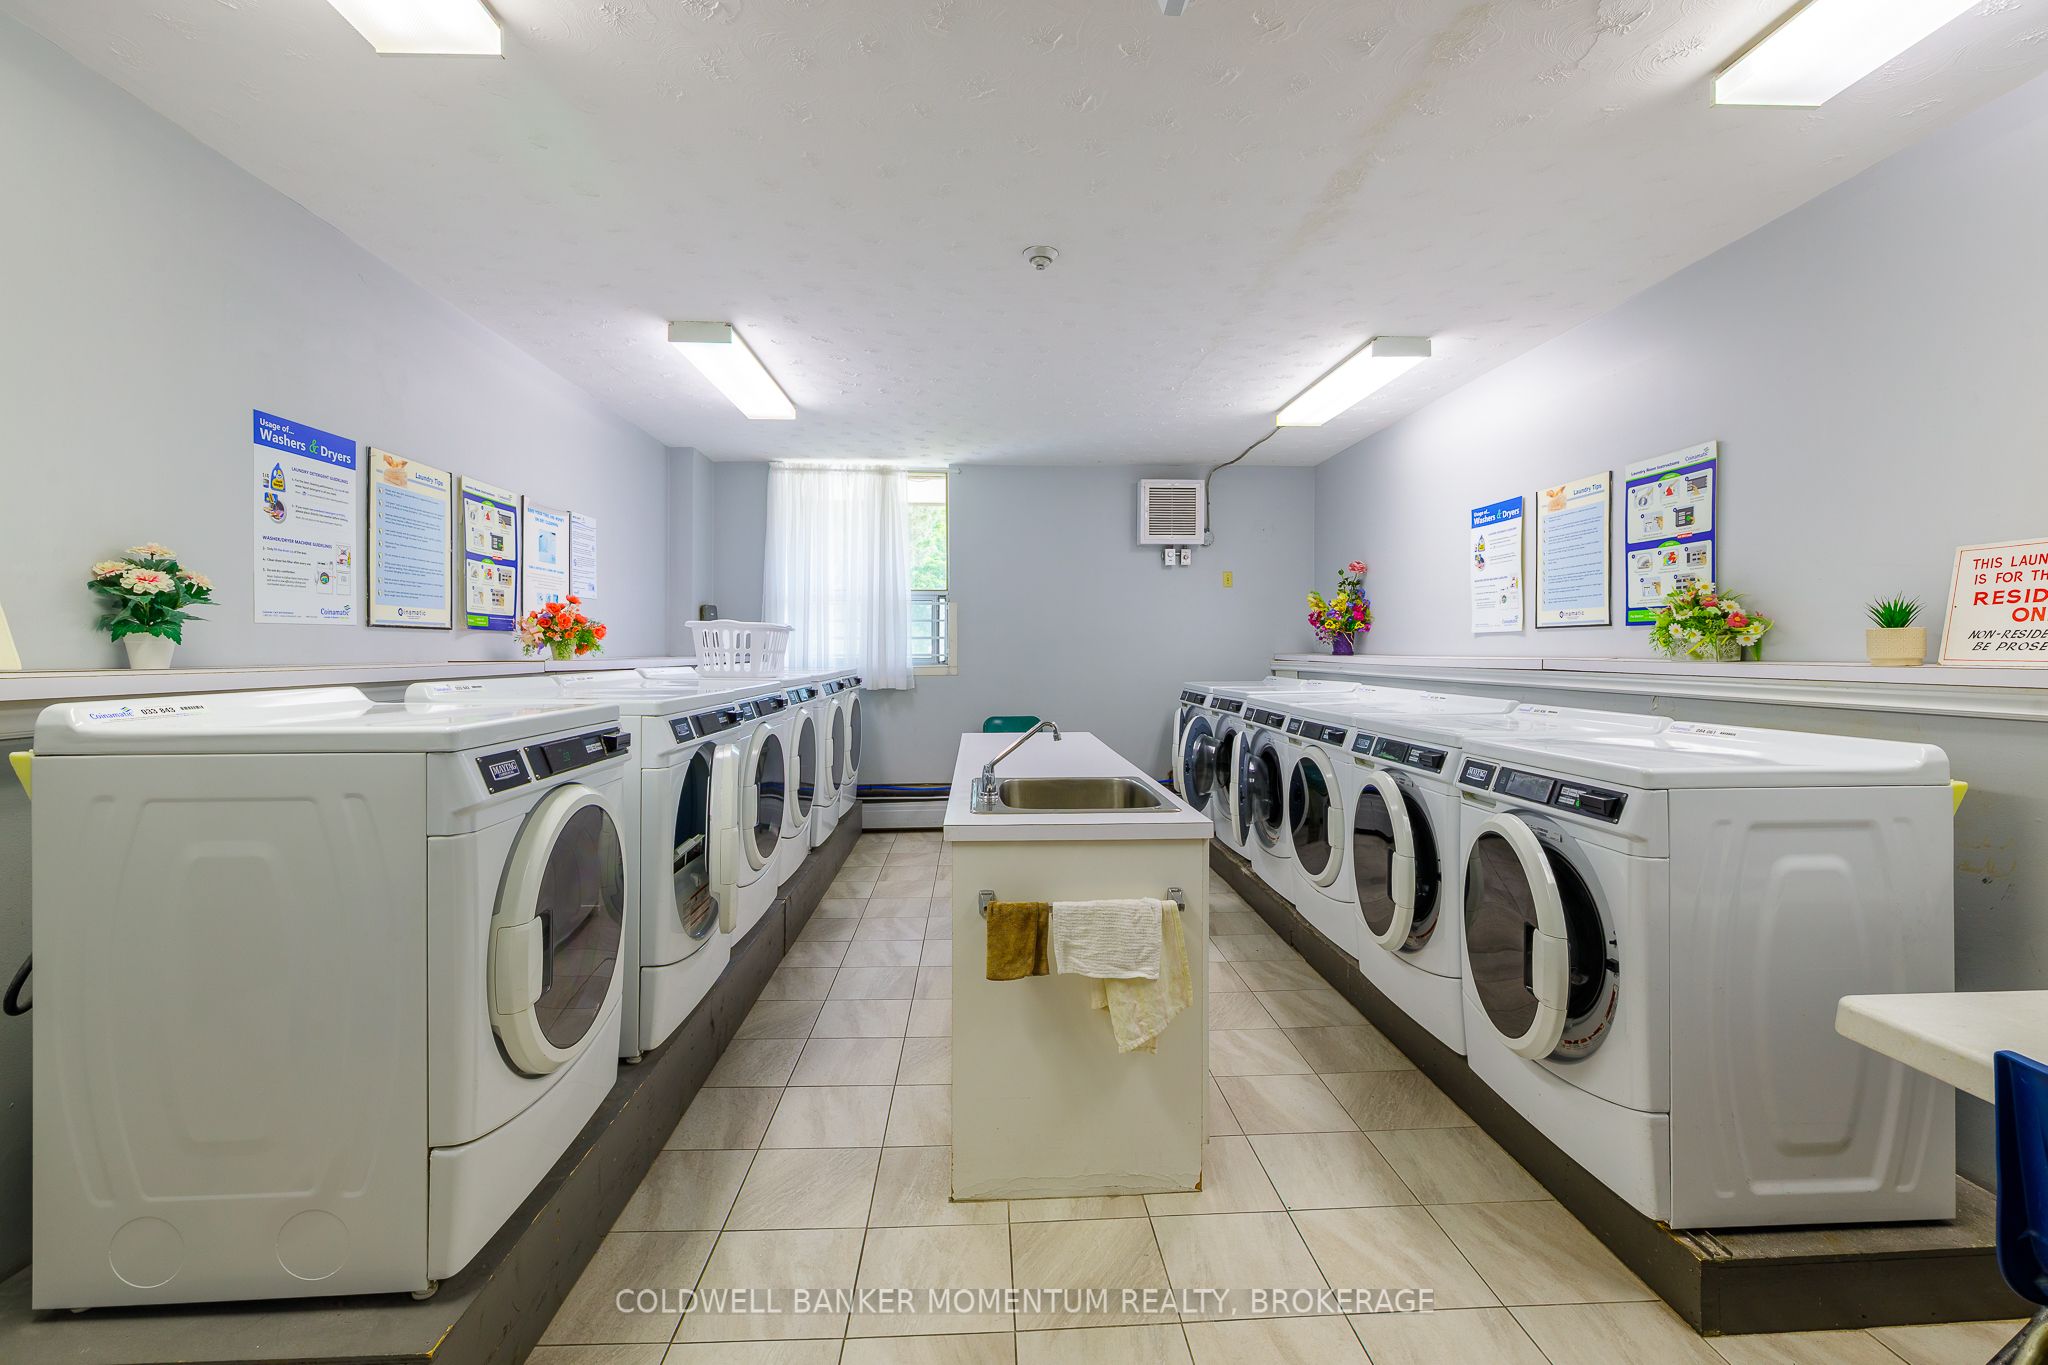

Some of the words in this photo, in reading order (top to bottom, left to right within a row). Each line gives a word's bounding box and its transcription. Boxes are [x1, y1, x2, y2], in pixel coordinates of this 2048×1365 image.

[259, 417, 281, 431] Usage
[260, 428, 306, 451] Washers
[309, 439, 319, 454] &
[320, 445, 351, 464] Dryers
[415, 472, 434, 485] Laundry
[1573, 486, 1591, 496] Laundry
[1473, 514, 1496, 526] Washers
[1496, 508, 1502, 519] &
[1502, 508, 1520, 519] Dryers
[1973, 557, 2003, 570] THIS
[1974, 573, 1987, 586] IS
[1995, 571, 2023, 583] FOR
[1971, 641, 1992, 651] BE
[89, 710, 134, 720] Coinamatic
[159, 706, 176, 714] 843
[492, 761, 517, 776] MAYTAG
